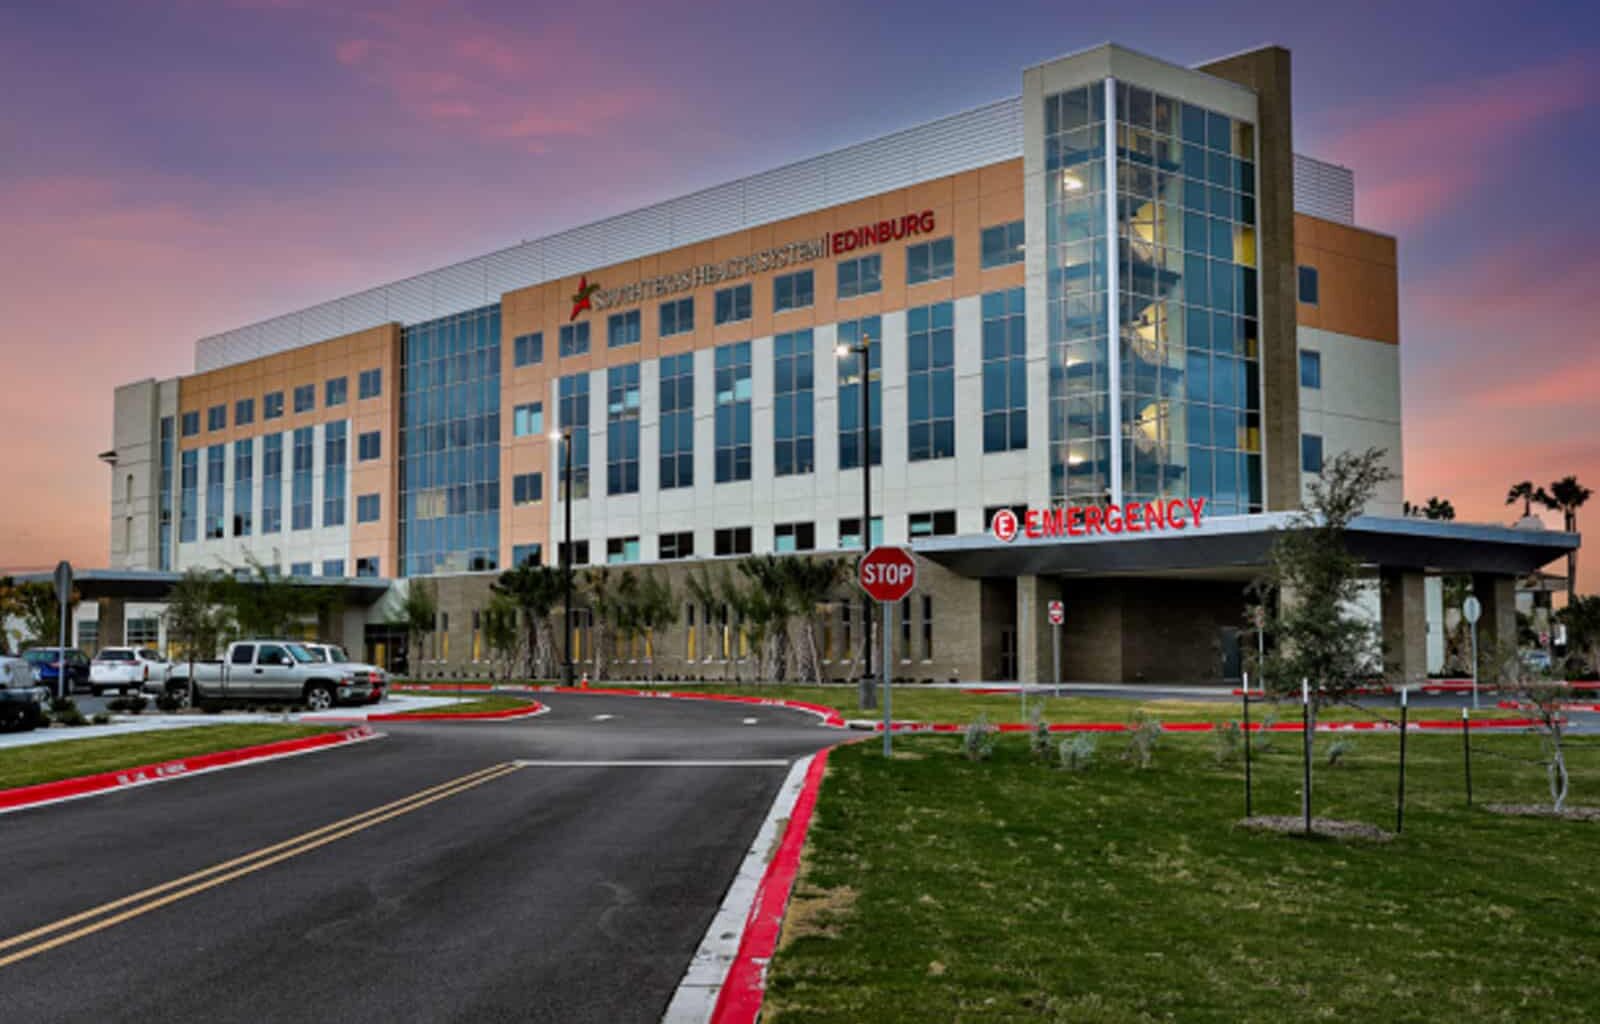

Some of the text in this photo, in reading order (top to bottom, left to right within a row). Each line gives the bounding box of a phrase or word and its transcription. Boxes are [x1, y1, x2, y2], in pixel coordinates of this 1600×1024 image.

[832, 209, 935, 256] EDINBURG
[1025, 497, 1205, 539] EMERGENCY
[864, 562, 912, 585] STOP
